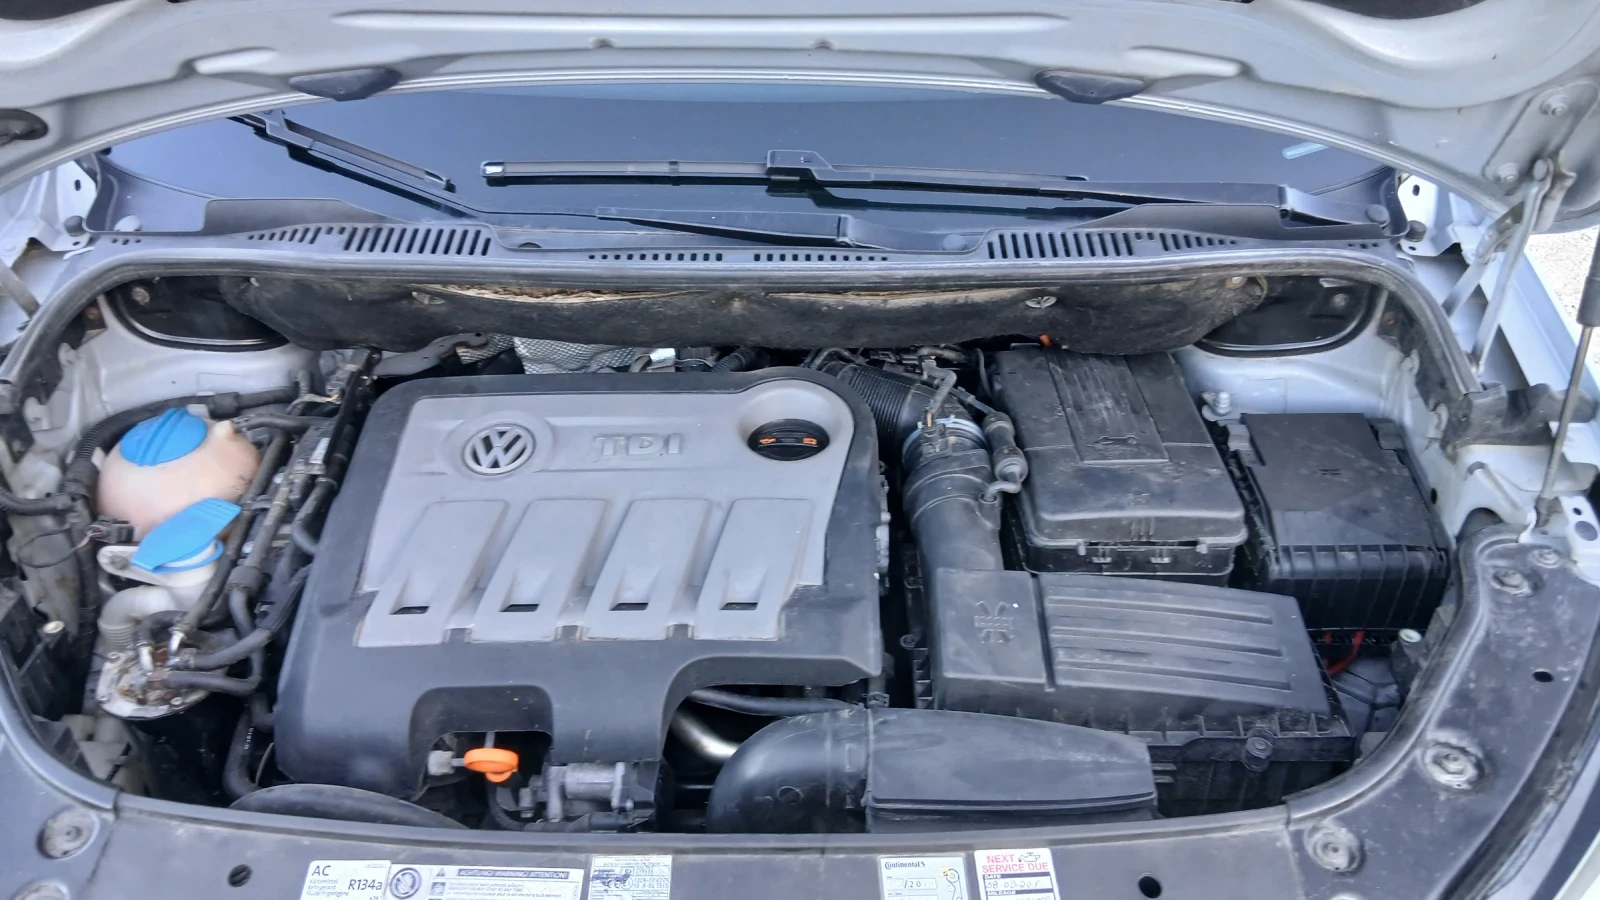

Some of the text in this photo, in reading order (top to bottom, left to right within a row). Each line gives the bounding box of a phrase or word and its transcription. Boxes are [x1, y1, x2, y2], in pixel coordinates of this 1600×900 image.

[596, 434, 684, 457] TDI
[987, 854, 1015, 864] NEXT
[311, 865, 331, 876] AC
[884, 862, 921, 870] Continental
[982, 862, 1050, 874] SERVICE DUE
[348, 879, 383, 890] R134a
